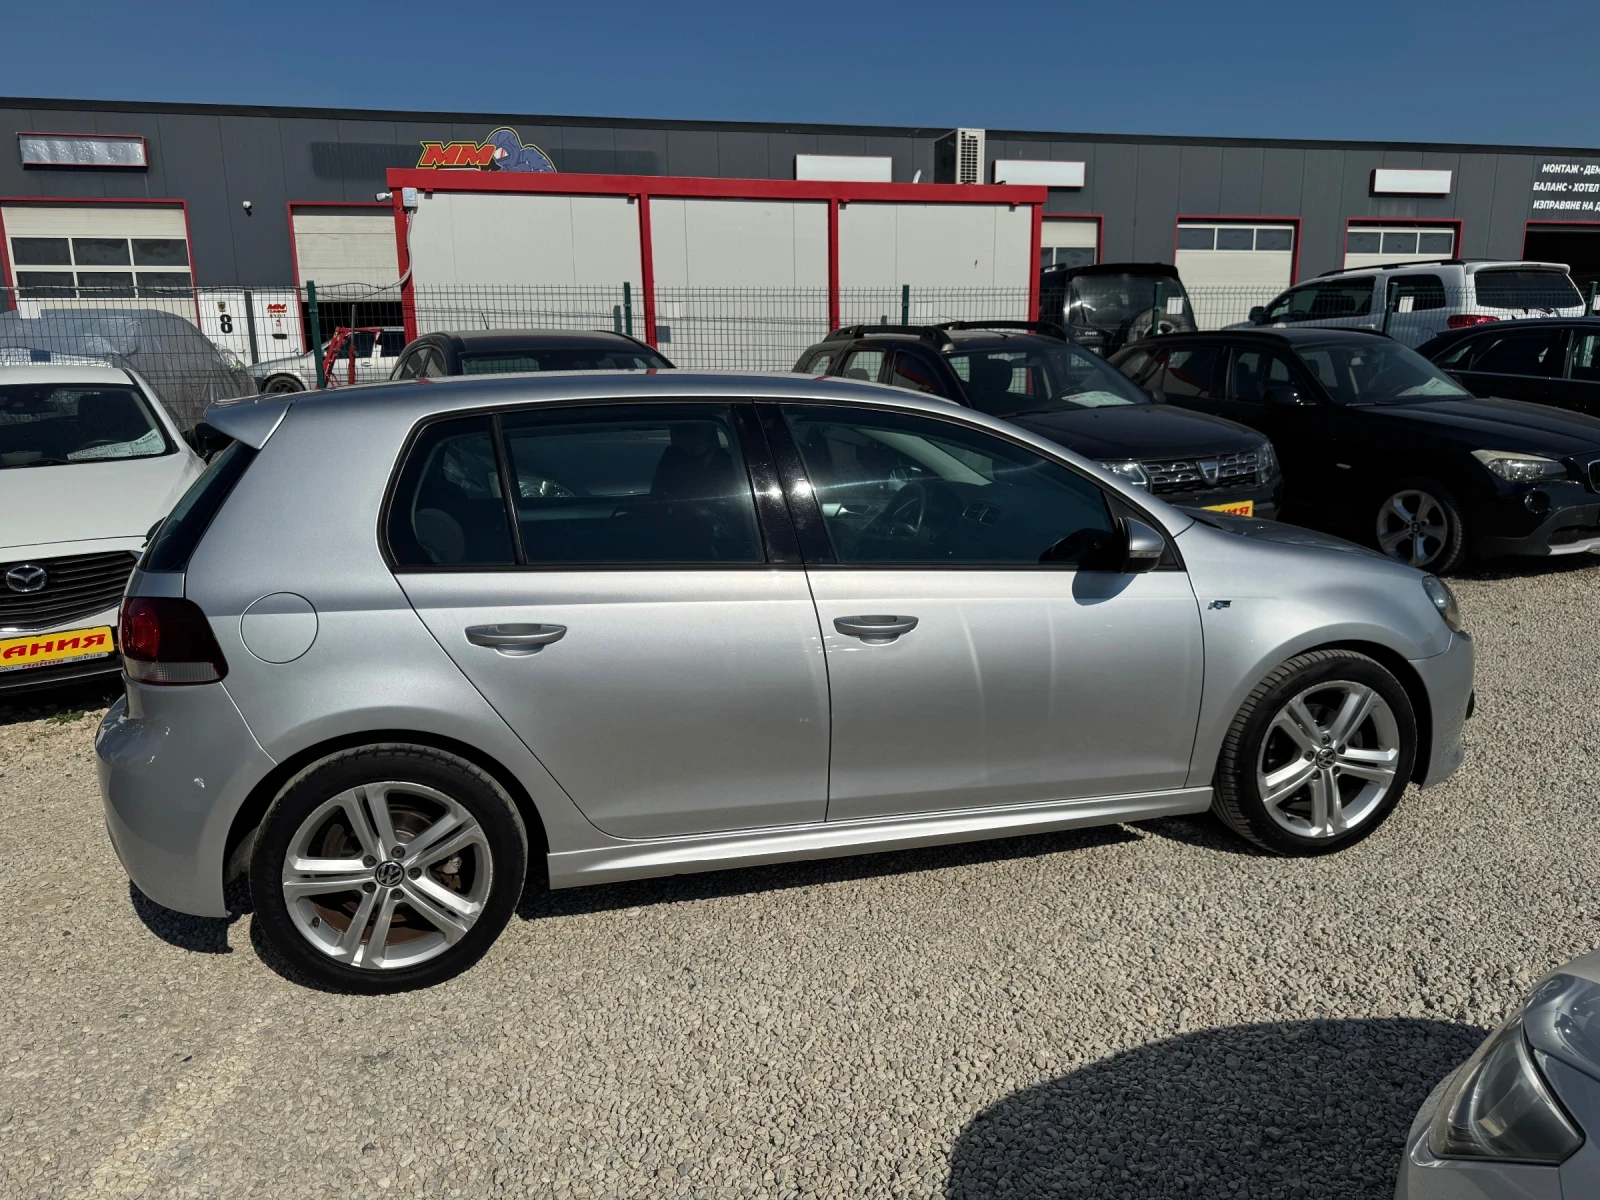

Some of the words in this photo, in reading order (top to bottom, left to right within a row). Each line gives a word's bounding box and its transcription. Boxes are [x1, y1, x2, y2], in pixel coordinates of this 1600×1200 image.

[420, 144, 497, 166] MM
[1542, 164, 1580, 174] МОНТАЖ
[1533, 182, 1568, 191] БАЛАНС
[1572, 183, 1600, 192] ХОТЕЛ
[1533, 200, 1581, 210] ИЗПРАВЯНЕ
[1582, 201, 1594, 210] НА
[220, 314, 233, 333] 8
[0, 634, 106, 659] АНИЯ
